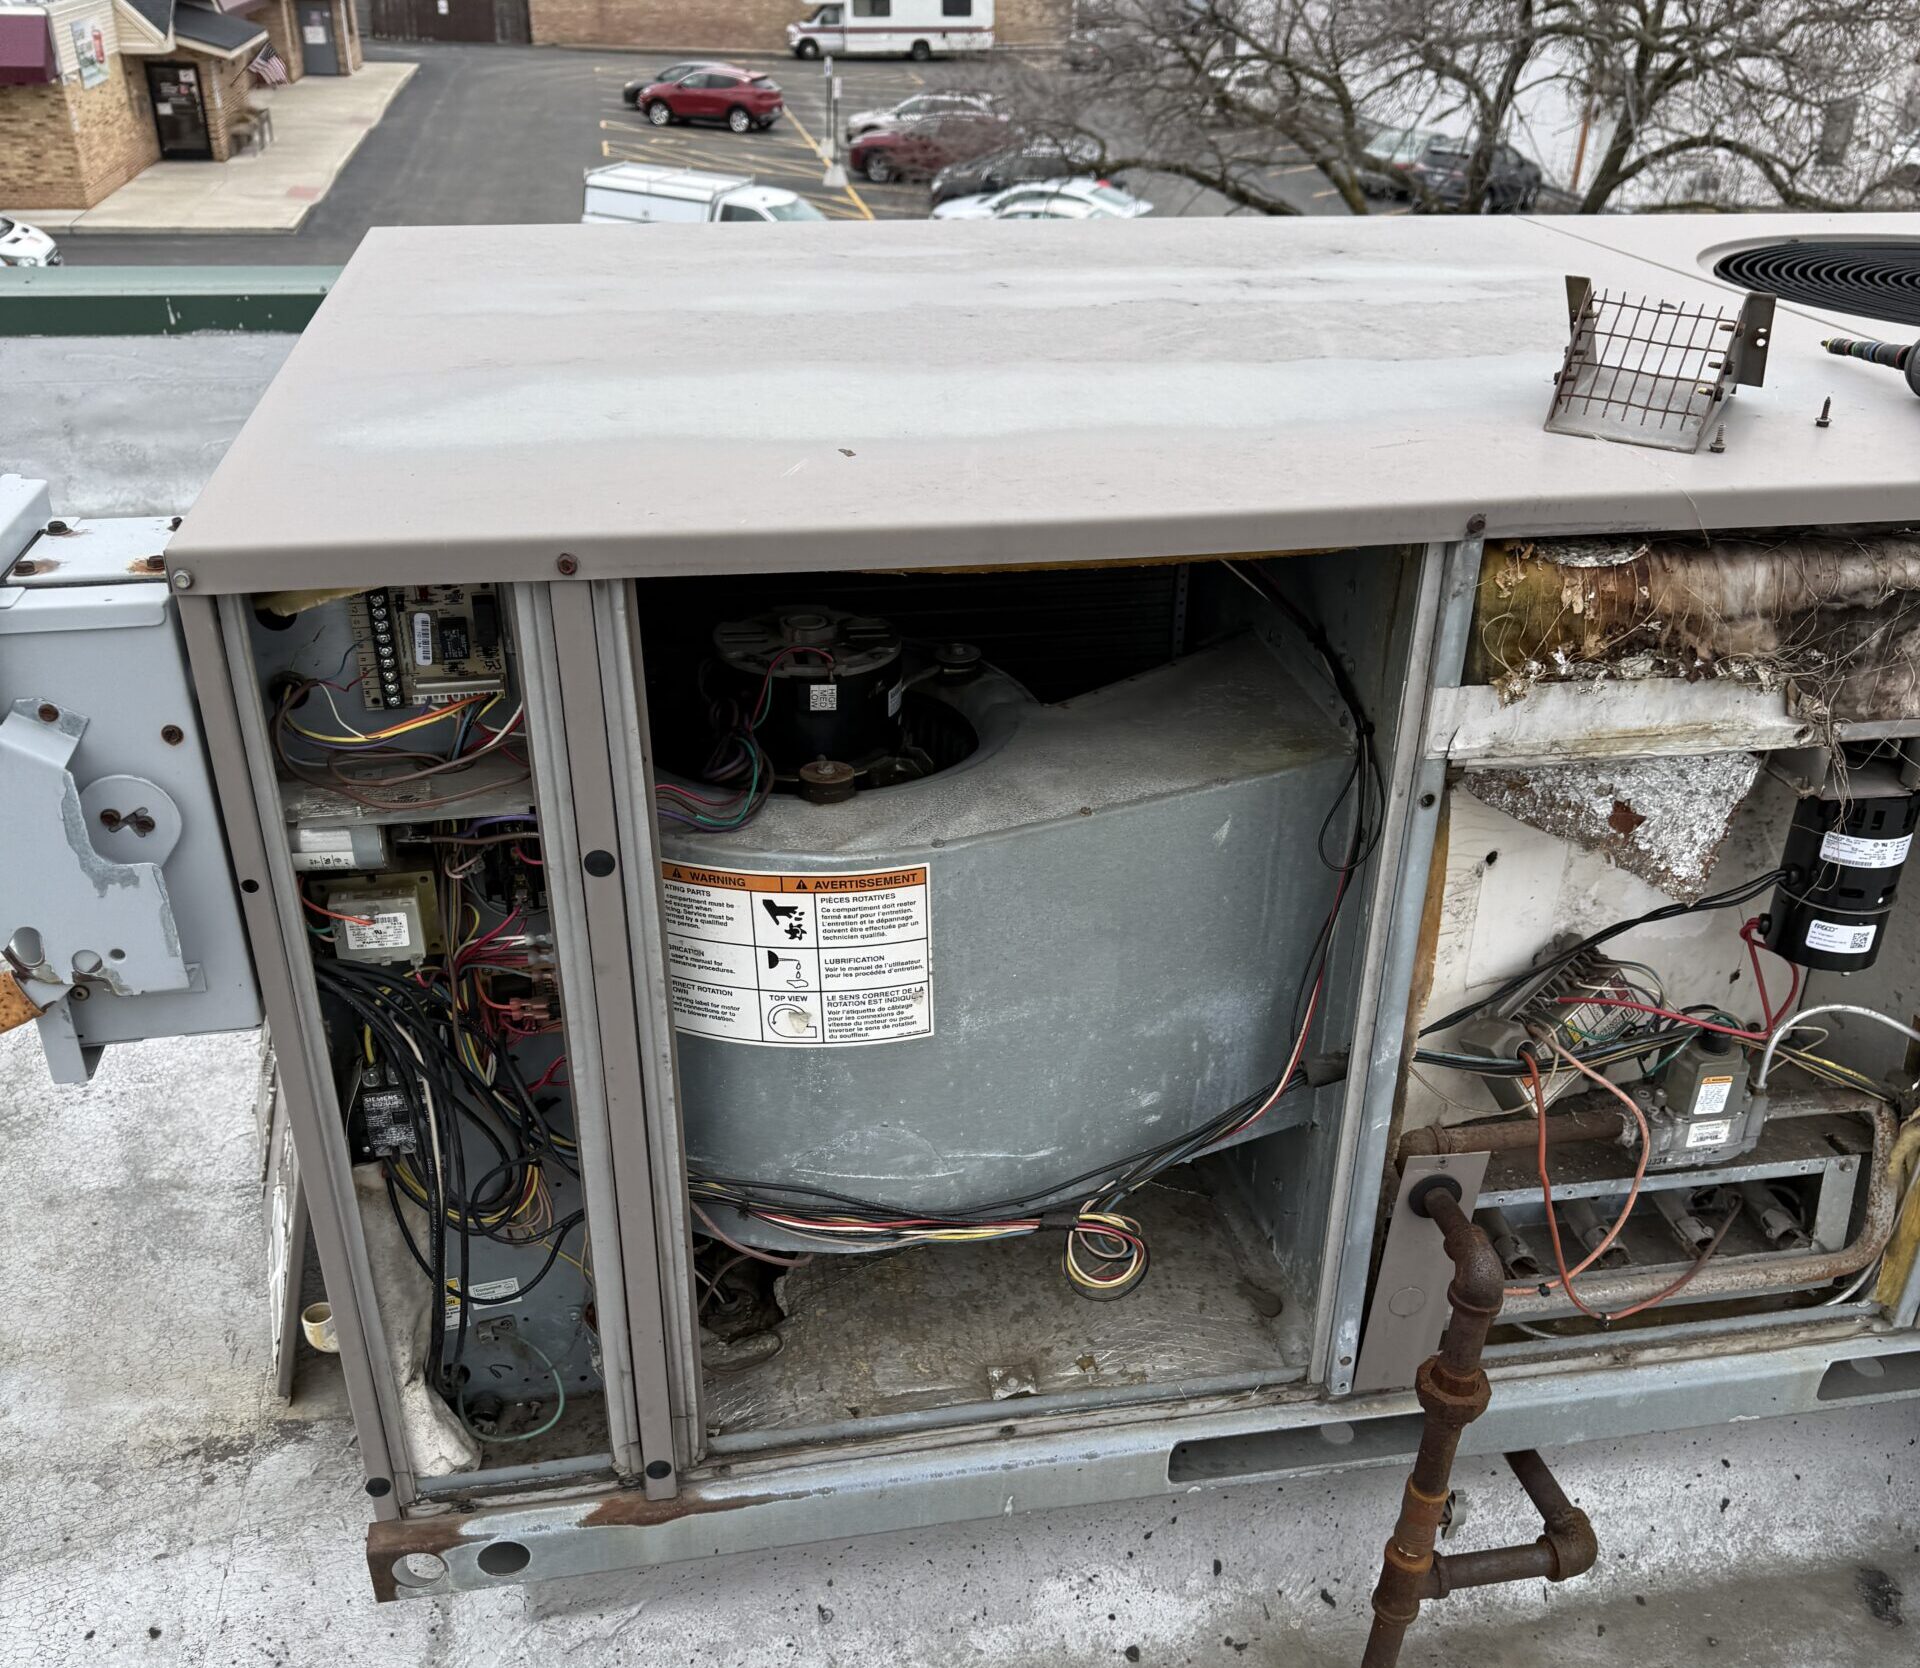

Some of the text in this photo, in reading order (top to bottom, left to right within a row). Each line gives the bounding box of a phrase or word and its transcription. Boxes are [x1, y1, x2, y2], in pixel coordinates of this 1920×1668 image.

[811, 690, 819, 708] LOW
[820, 690, 828, 708] MED
[828, 688, 836, 708] HIGH
[690, 871, 745, 886] WARNING
[815, 873, 917, 889] AVERTISSEMENT
[687, 887, 710, 896] PARTS
[709, 898, 724, 906] must
[853, 893, 895, 902] ROTATIVES
[674, 900, 693, 909] except
[833, 904, 880, 914] compartiment
[683, 909, 706, 917] Service
[709, 911, 724, 920] must
[860, 912, 876, 920] pour
[878, 908, 913, 916] l'entretien.
[700, 918, 727, 927] qualified
[876, 915, 913, 924] dépannage
[678, 920, 700, 929] person.
[865, 923, 896, 931] effectués
[860, 931, 887, 939] qualifié.
[690, 957, 712, 965] manual
[825, 955, 885, 965] LUBRIFICATION
[885, 959, 920, 968] l'utilisateur
[698, 964, 735, 974] procedures.
[855, 970, 886, 978] procédés
[888, 965, 924, 974] d'entretien.
[697, 985, 733, 996] ROTATION
[862, 990, 899, 999] CORRECT
[677, 995, 693, 1004] wiring
[827, 1000, 866, 1008] ROTATION
[684, 1003, 719, 1014] connections
[888, 1003, 912, 1012] câblage
[688, 1009, 707, 1018] blower
[709, 1013, 735, 1022] rotation.
[857, 1012, 894, 1020] connexions
[364, 1094, 398, 1102] SIEMENS
